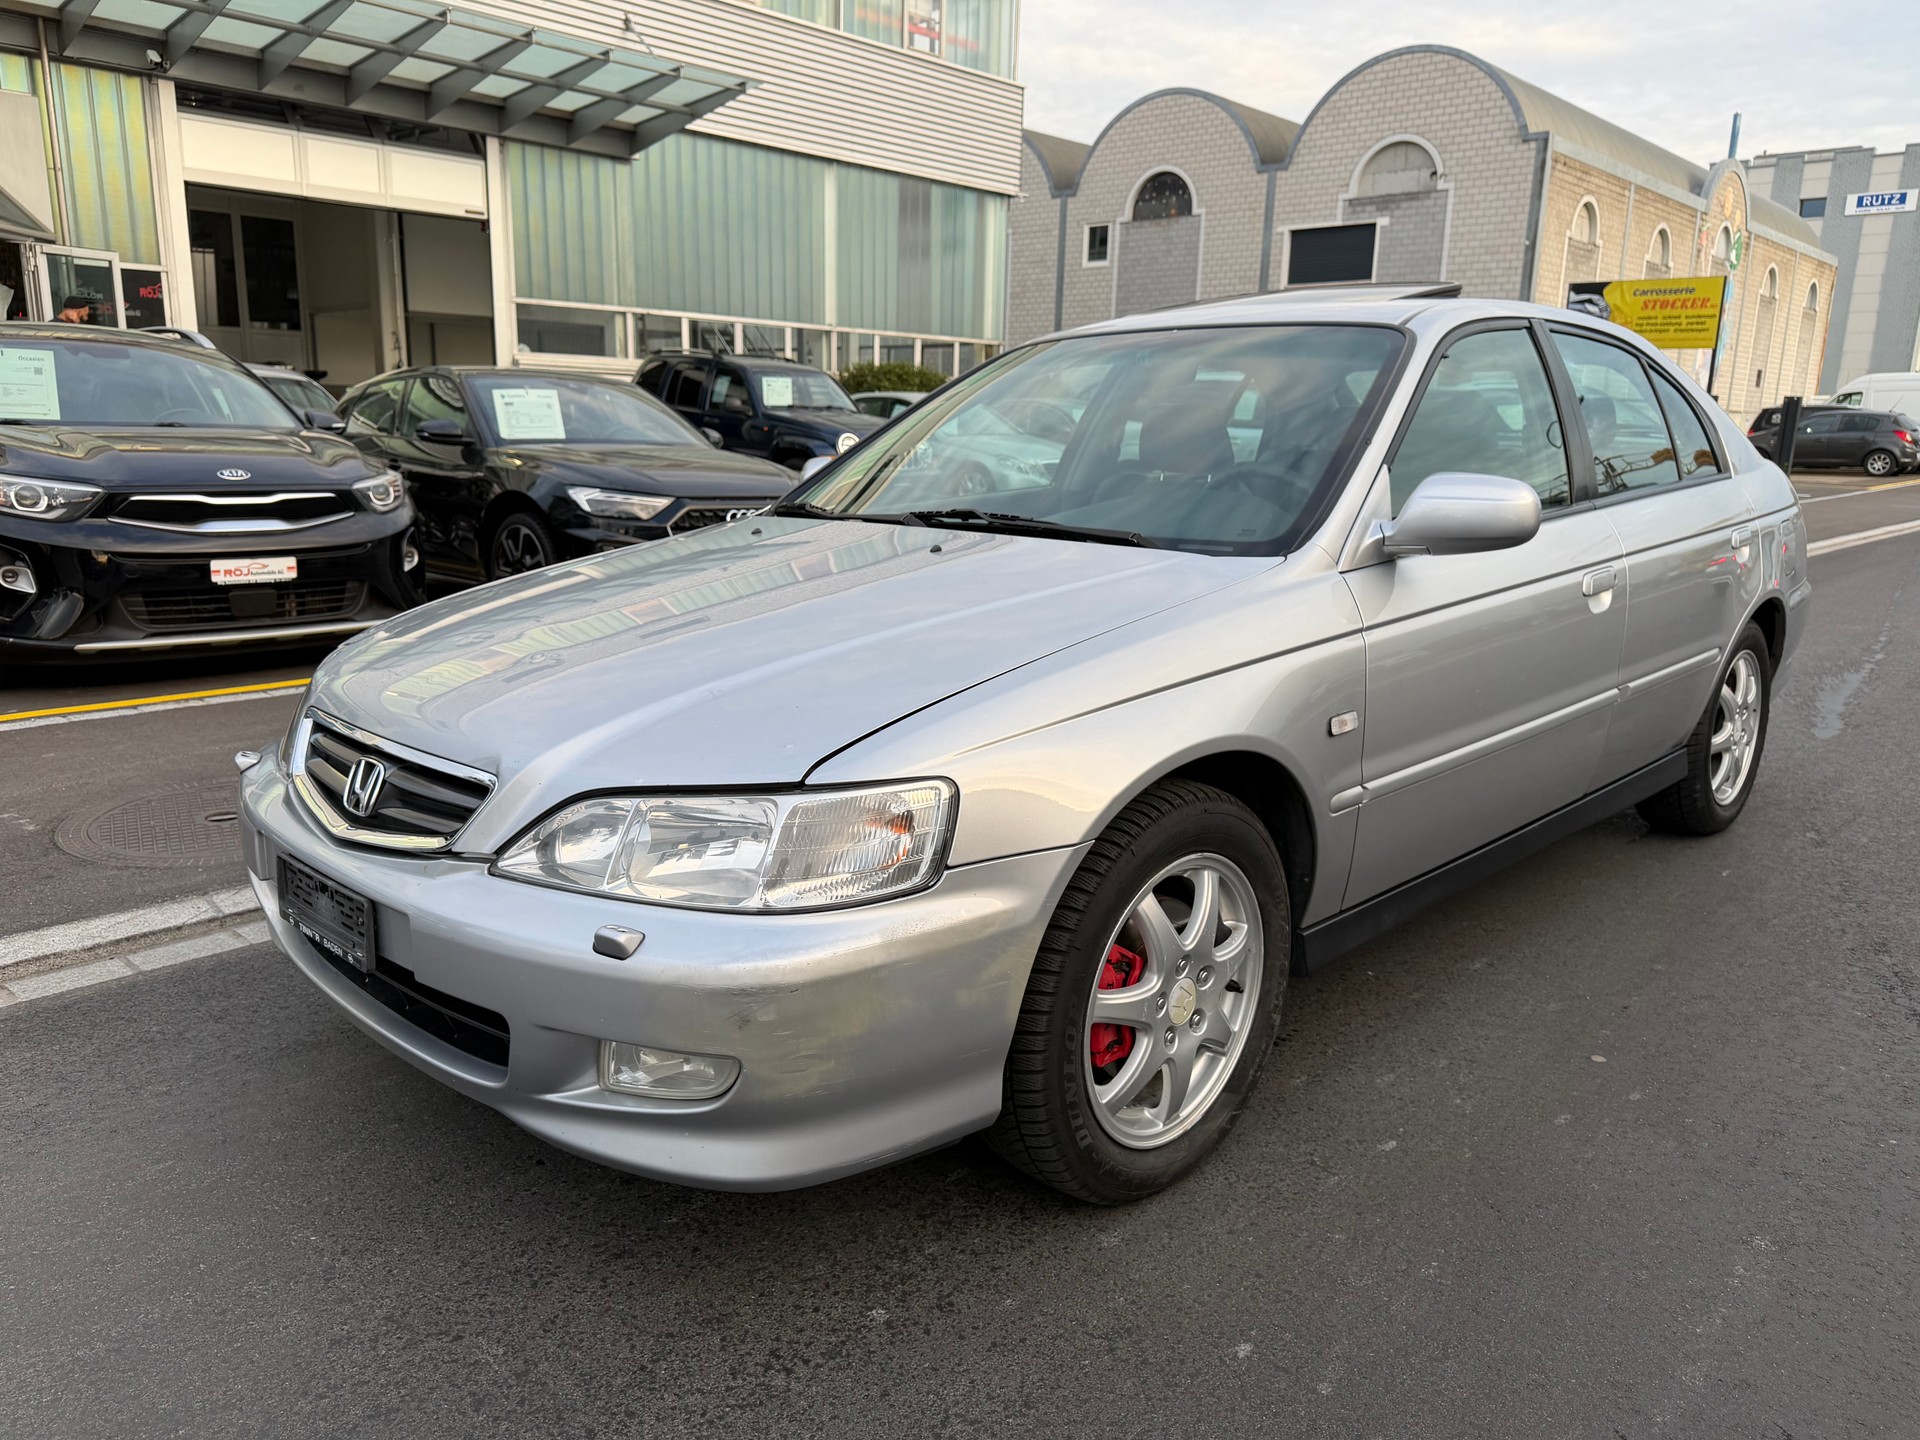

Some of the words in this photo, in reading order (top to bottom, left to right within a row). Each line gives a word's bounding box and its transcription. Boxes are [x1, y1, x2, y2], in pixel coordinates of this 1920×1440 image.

[1862, 194, 1901, 207] RUTZ
[1633, 286, 1696, 297] Carrosserie
[1641, 297, 1711, 311] STOCKER
